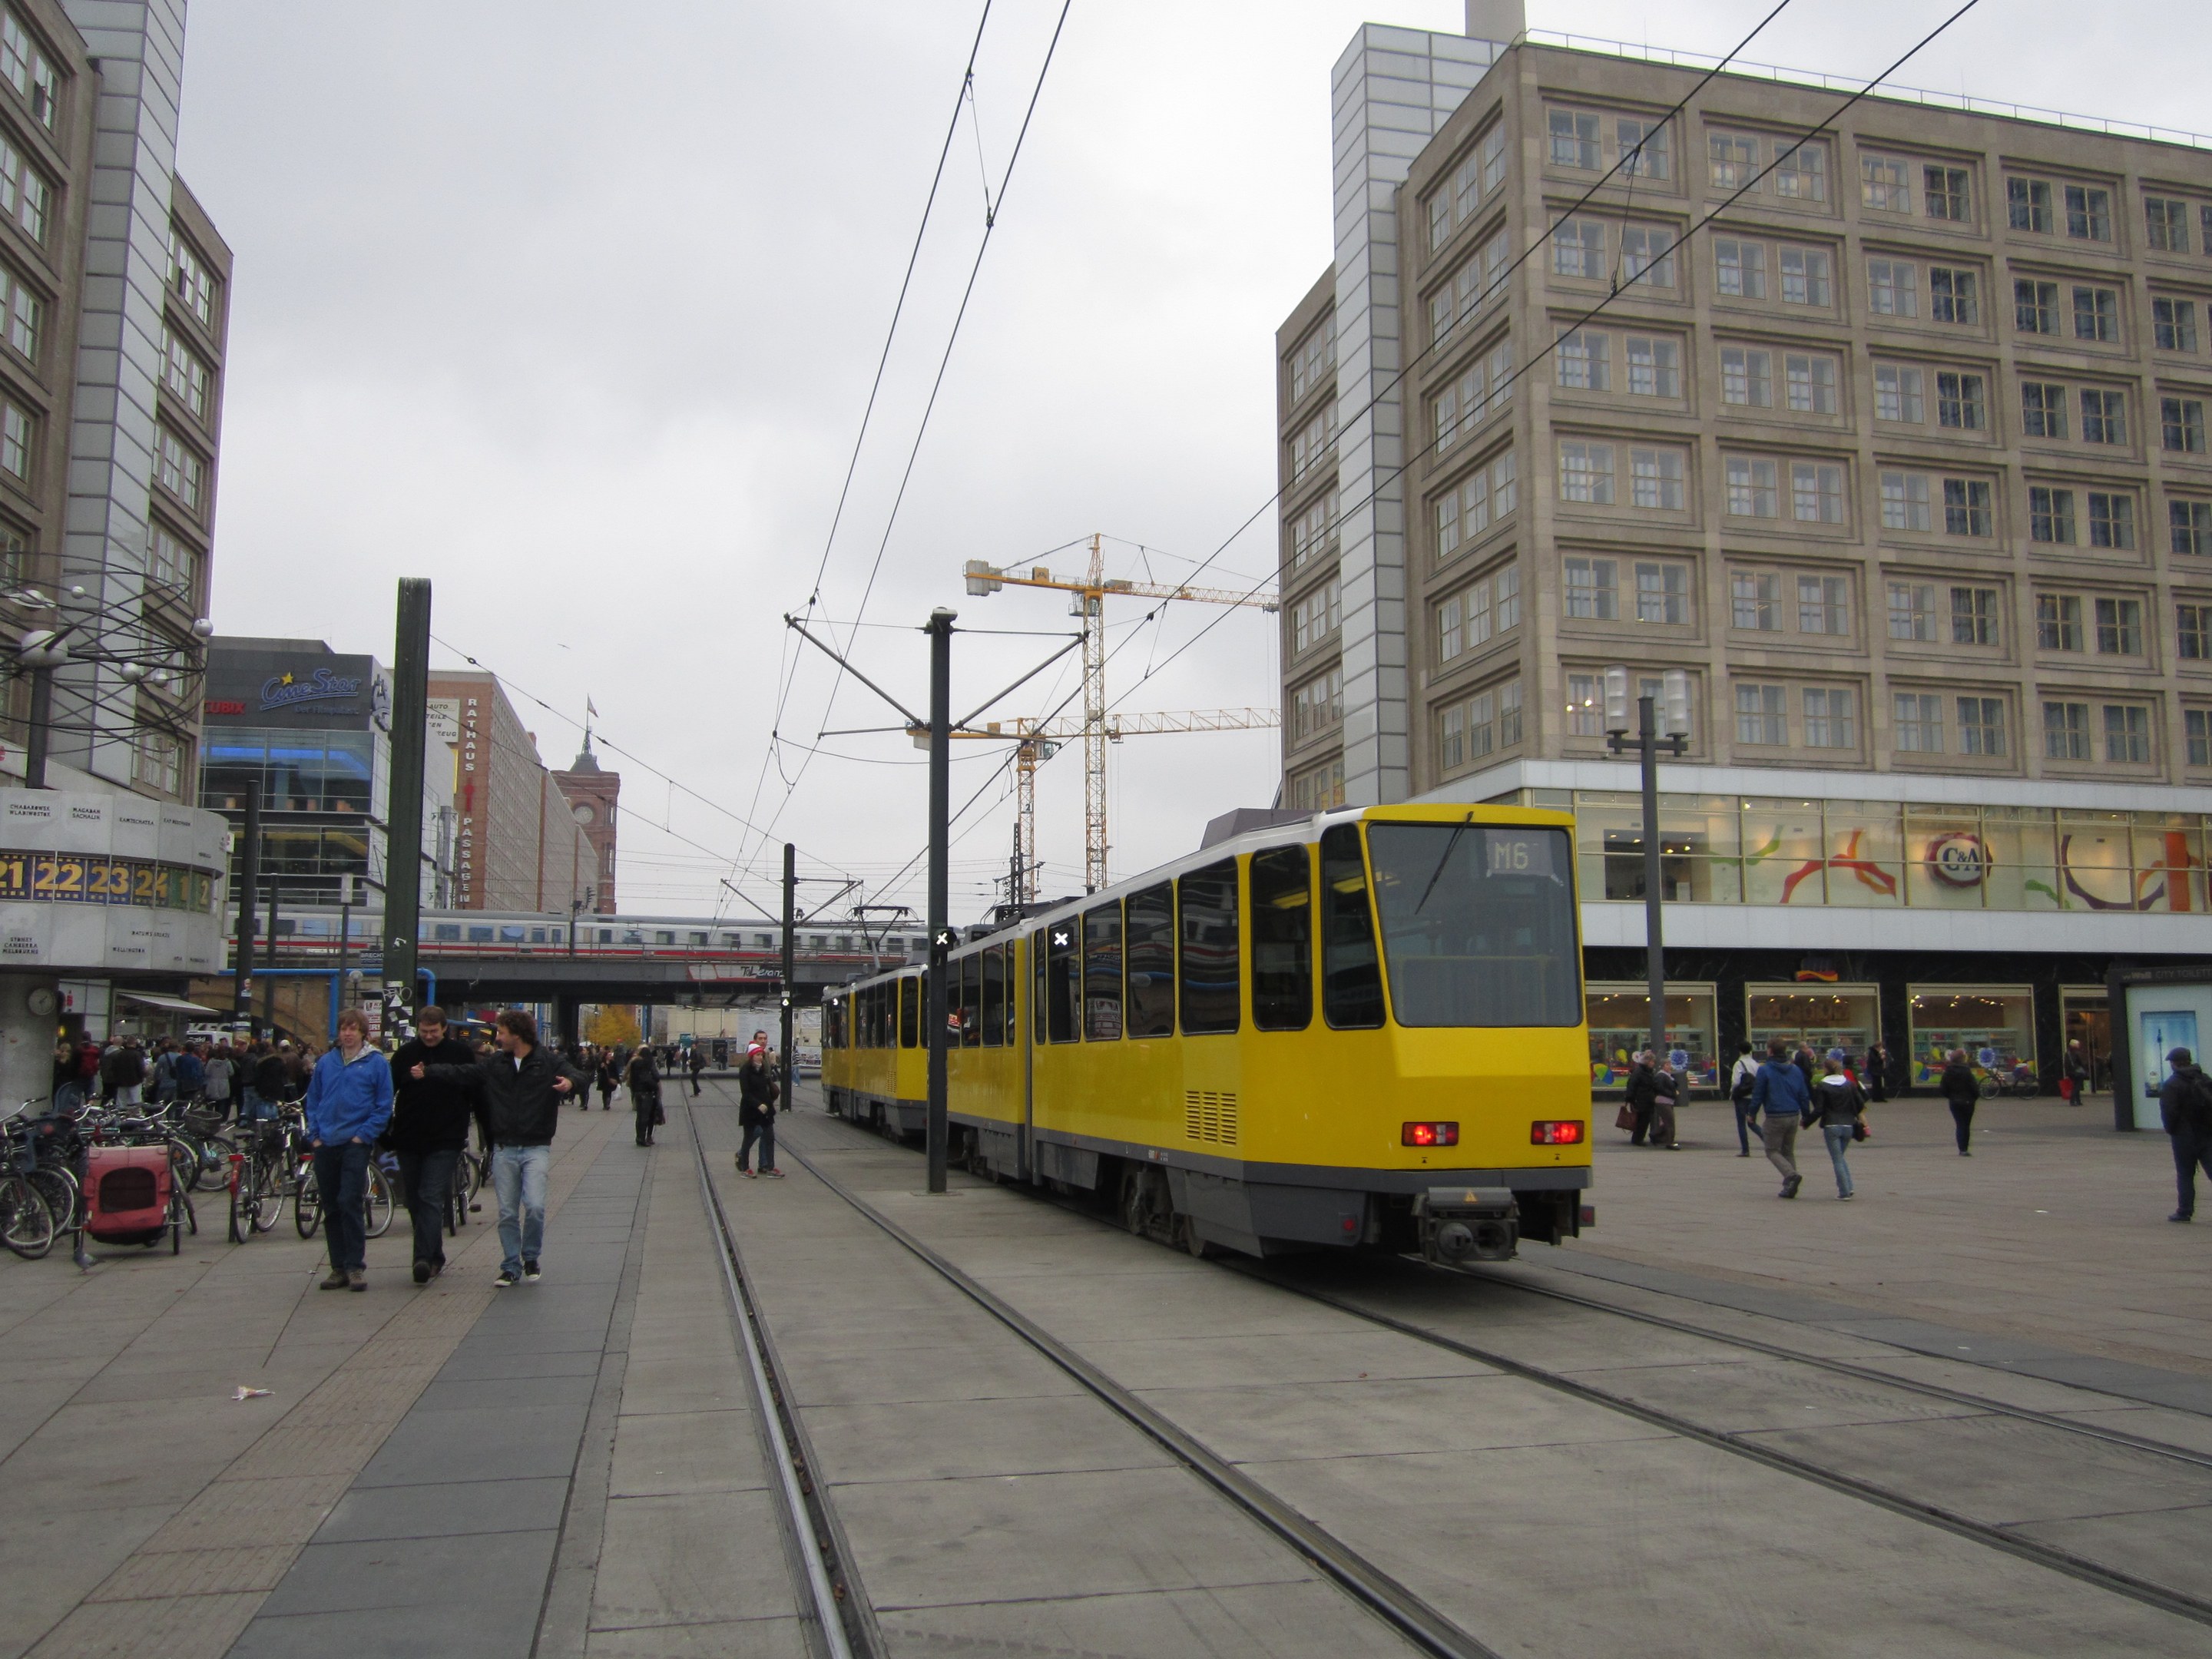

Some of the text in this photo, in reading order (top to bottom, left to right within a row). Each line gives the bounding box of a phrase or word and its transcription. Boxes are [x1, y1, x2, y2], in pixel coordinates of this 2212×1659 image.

[261, 668, 361, 704] CineStar
[465, 698, 477, 771] RATHAUS
[460, 817, 472, 902] PASSAGEN
[1494, 842, 1529, 869] M6
[1942, 847, 1981, 871] C&A
[35, 863, 83, 891] 22
[89, 866, 130, 896] 23
[135, 869, 168, 899] 24
